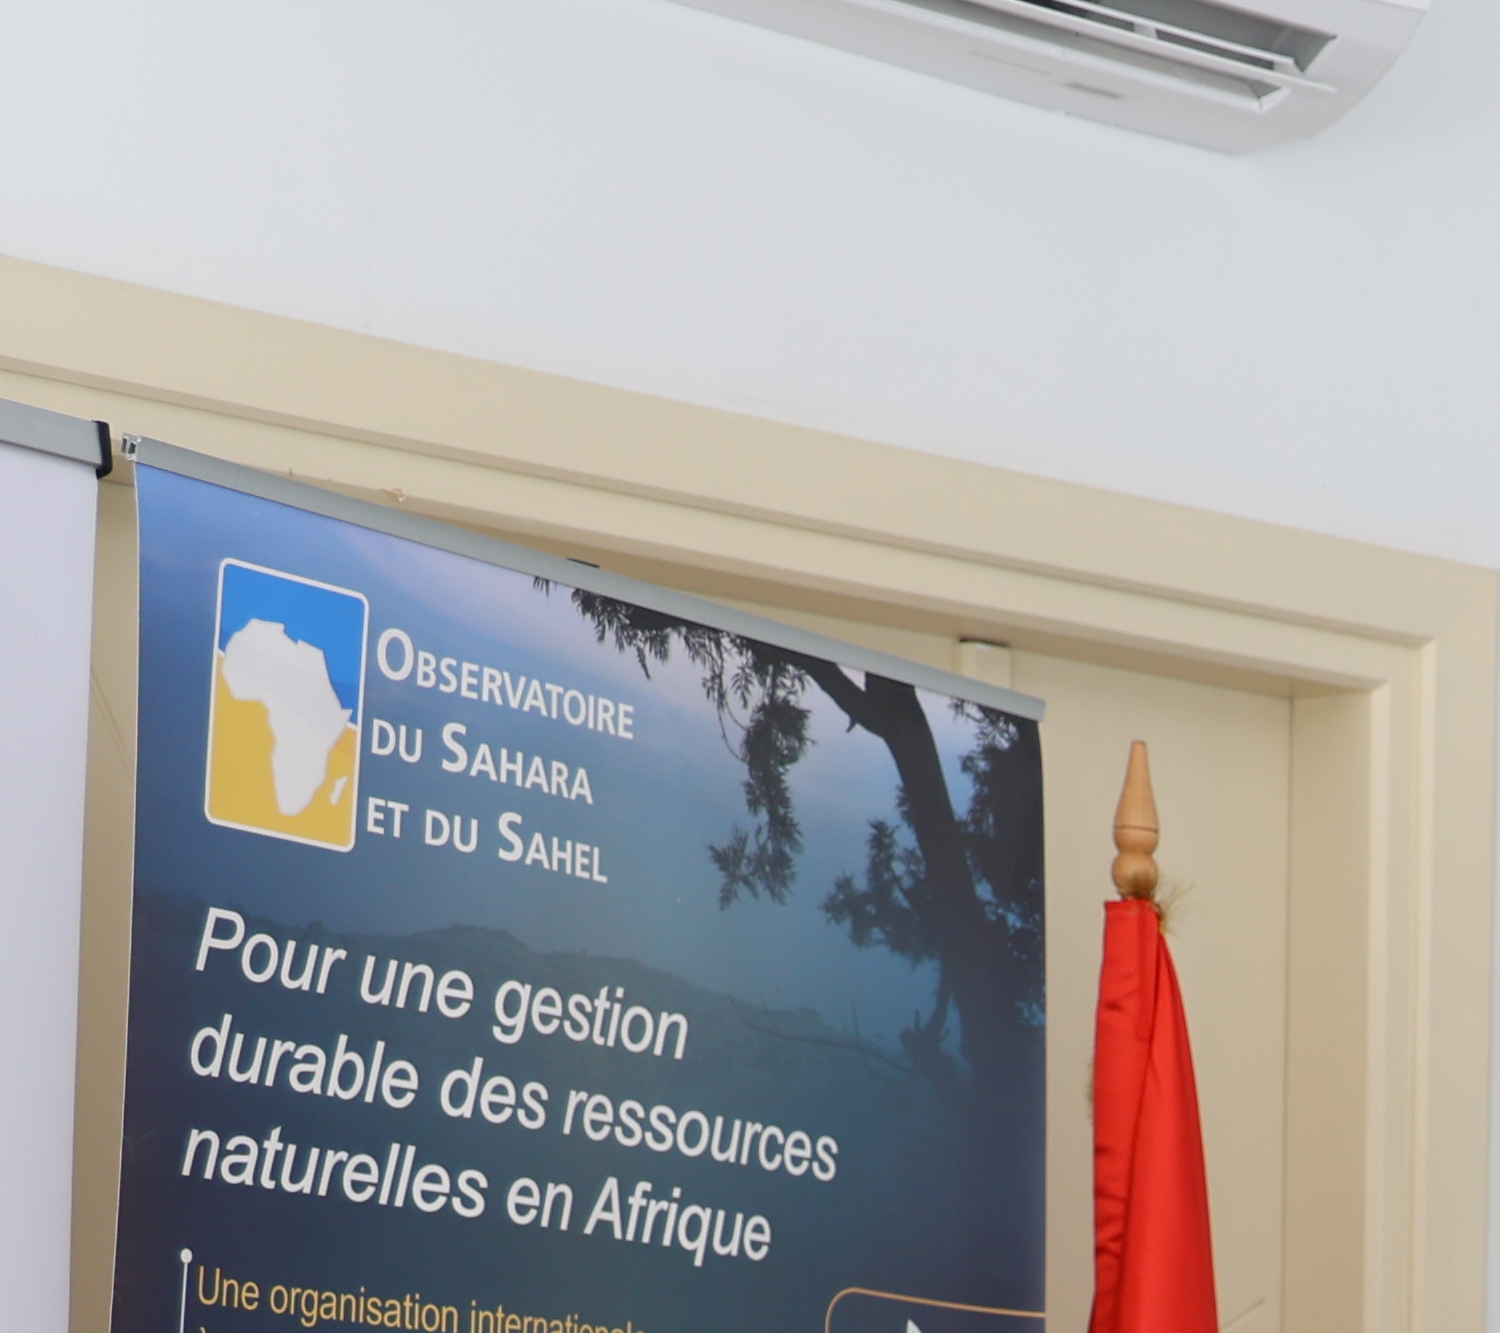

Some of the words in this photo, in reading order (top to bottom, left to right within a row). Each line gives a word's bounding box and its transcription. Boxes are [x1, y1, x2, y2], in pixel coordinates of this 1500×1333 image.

[195, 906, 348, 995] Pour
[359, 954, 474, 1019] une
[492, 980, 688, 1060] gestion
[190, 1013, 419, 1109] durable
[440, 1056, 549, 1130] des
[562, 1089, 839, 1182] ressources
[181, 1125, 489, 1218] naturelles
[506, 1177, 573, 1231] en
[583, 1176, 771, 1267] Afrique
[198, 1265, 260, 1311] Une
